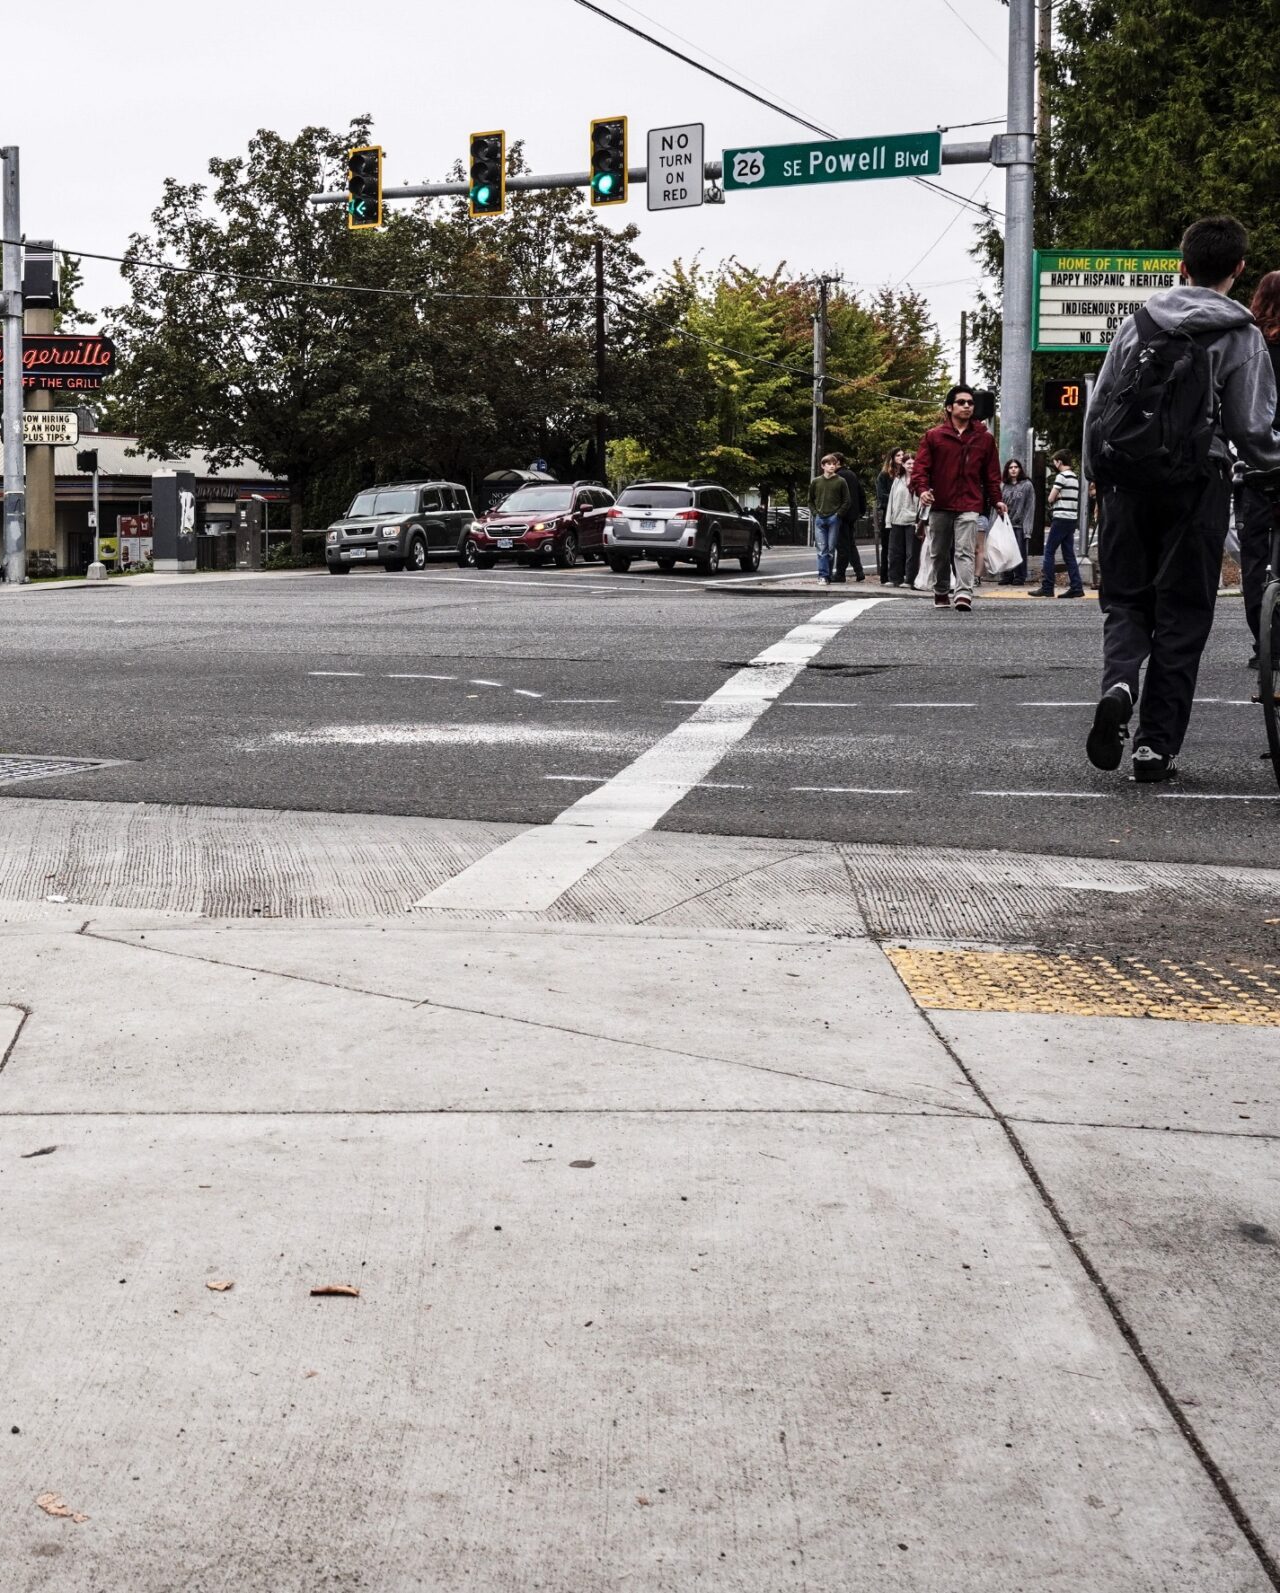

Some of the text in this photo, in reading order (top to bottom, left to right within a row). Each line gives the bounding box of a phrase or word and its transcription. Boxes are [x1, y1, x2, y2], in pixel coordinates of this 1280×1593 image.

[661, 133, 689, 152] NO
[658, 153, 692, 168] TURN
[736, 145, 929, 177] 26 SE Powell Blvd
[665, 172, 685, 185] ON
[662, 188, 688, 202] RED
[1058, 257, 1091, 271] HOME
[1095, 257, 1111, 271] OF
[1116, 258, 1138, 271] THE
[1051, 273, 1081, 287] HAPPY
[1083, 274, 1125, 287] HISPANIC
[1129, 274, 1174, 287] HERITAGE
[1061, 302, 1144, 315] INDIGENOUS PEOP
[1080, 331, 1092, 344] NO
[21, 377, 36, 388] FF
[41, 377, 63, 388] THE
[66, 377, 101, 389] GRILL
[1060, 386, 1079, 406] 20
[41, 415, 70, 423] HIRING
[31, 424, 42, 432] AN
[44, 424, 67, 432] HOUR
[23, 433, 65, 441] PLUS TIPS
